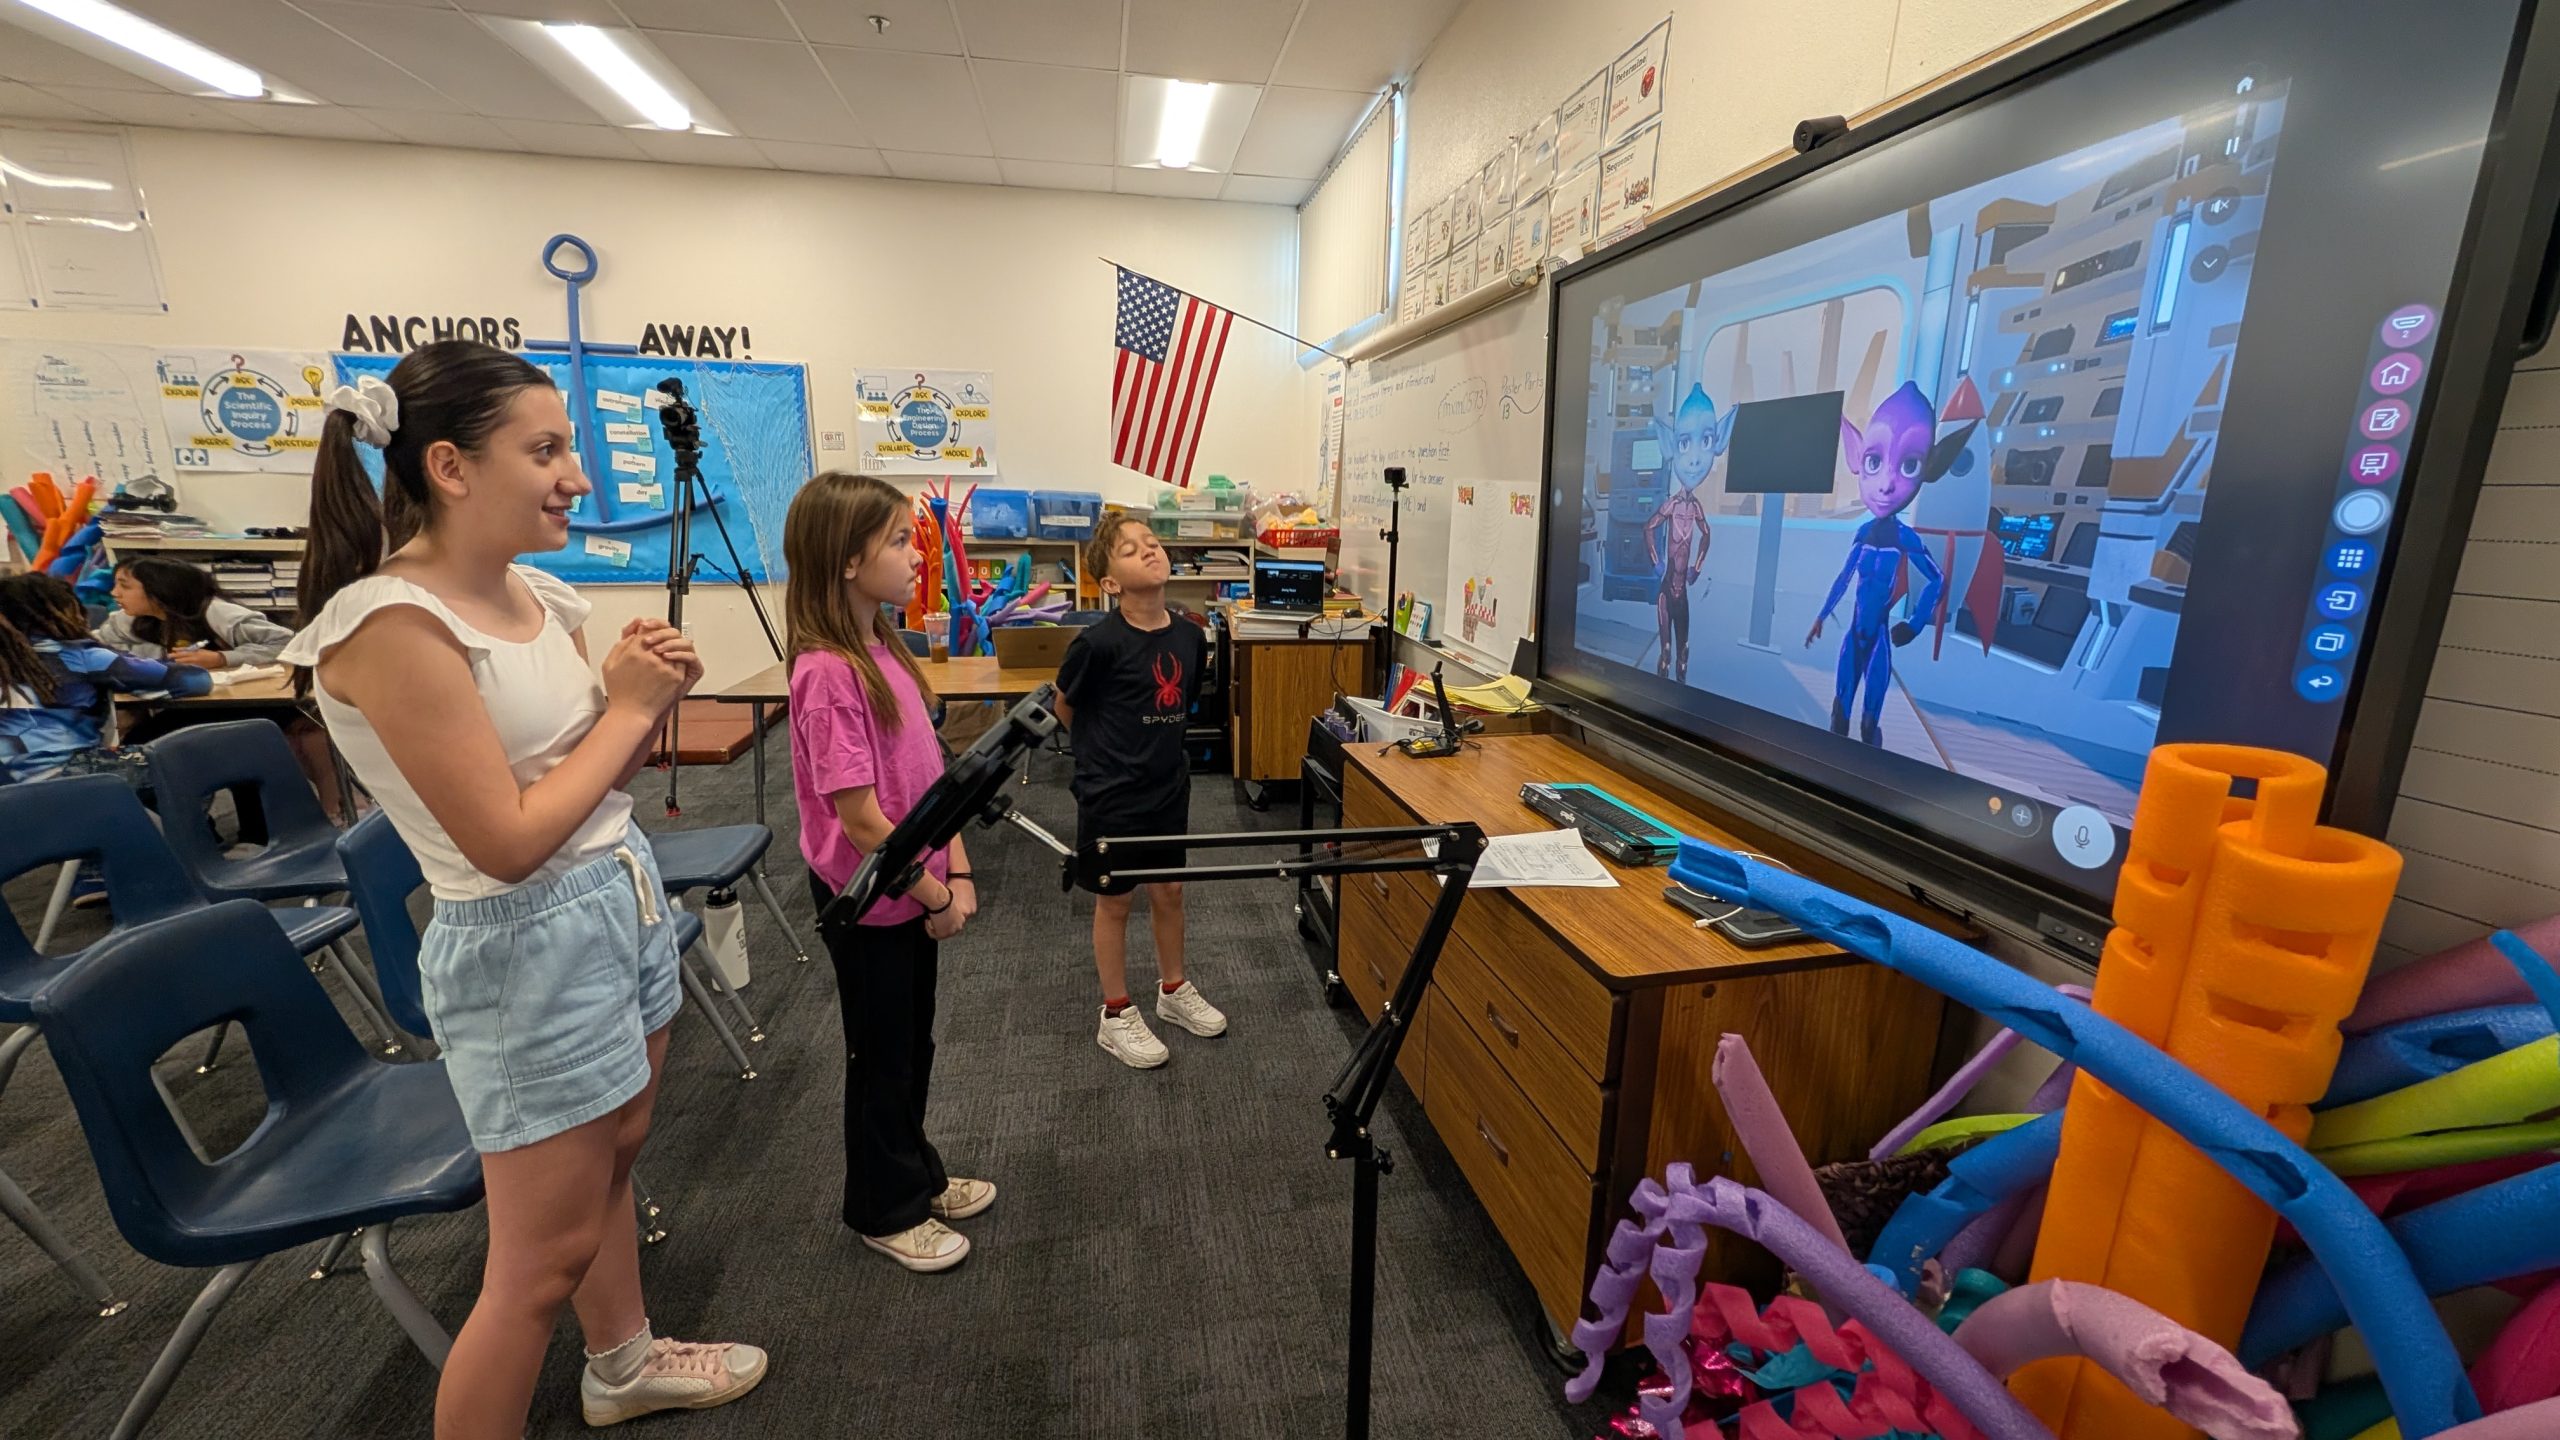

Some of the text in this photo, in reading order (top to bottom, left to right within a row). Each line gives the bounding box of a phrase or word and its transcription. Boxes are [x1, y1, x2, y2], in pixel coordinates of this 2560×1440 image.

[1615, 56, 1647, 84] Determine
[1606, 153, 1634, 173] Sequence
[342, 313, 753, 360] ANCHORS AWAY!
[2402, 330, 2409, 338] 2
[237, 391, 256, 400] The
[223, 402, 273, 411] Scientific
[917, 406, 930, 414] The
[231, 412, 267, 422] Inquiry
[955, 408, 987, 418] EXPLORE
[230, 420, 272, 430] Process
[910, 429, 940, 437] Process
[878, 445, 913, 453] EVALUATE
[944, 450, 969, 458] MODEL
[1142, 713, 1185, 724] SPYDER
